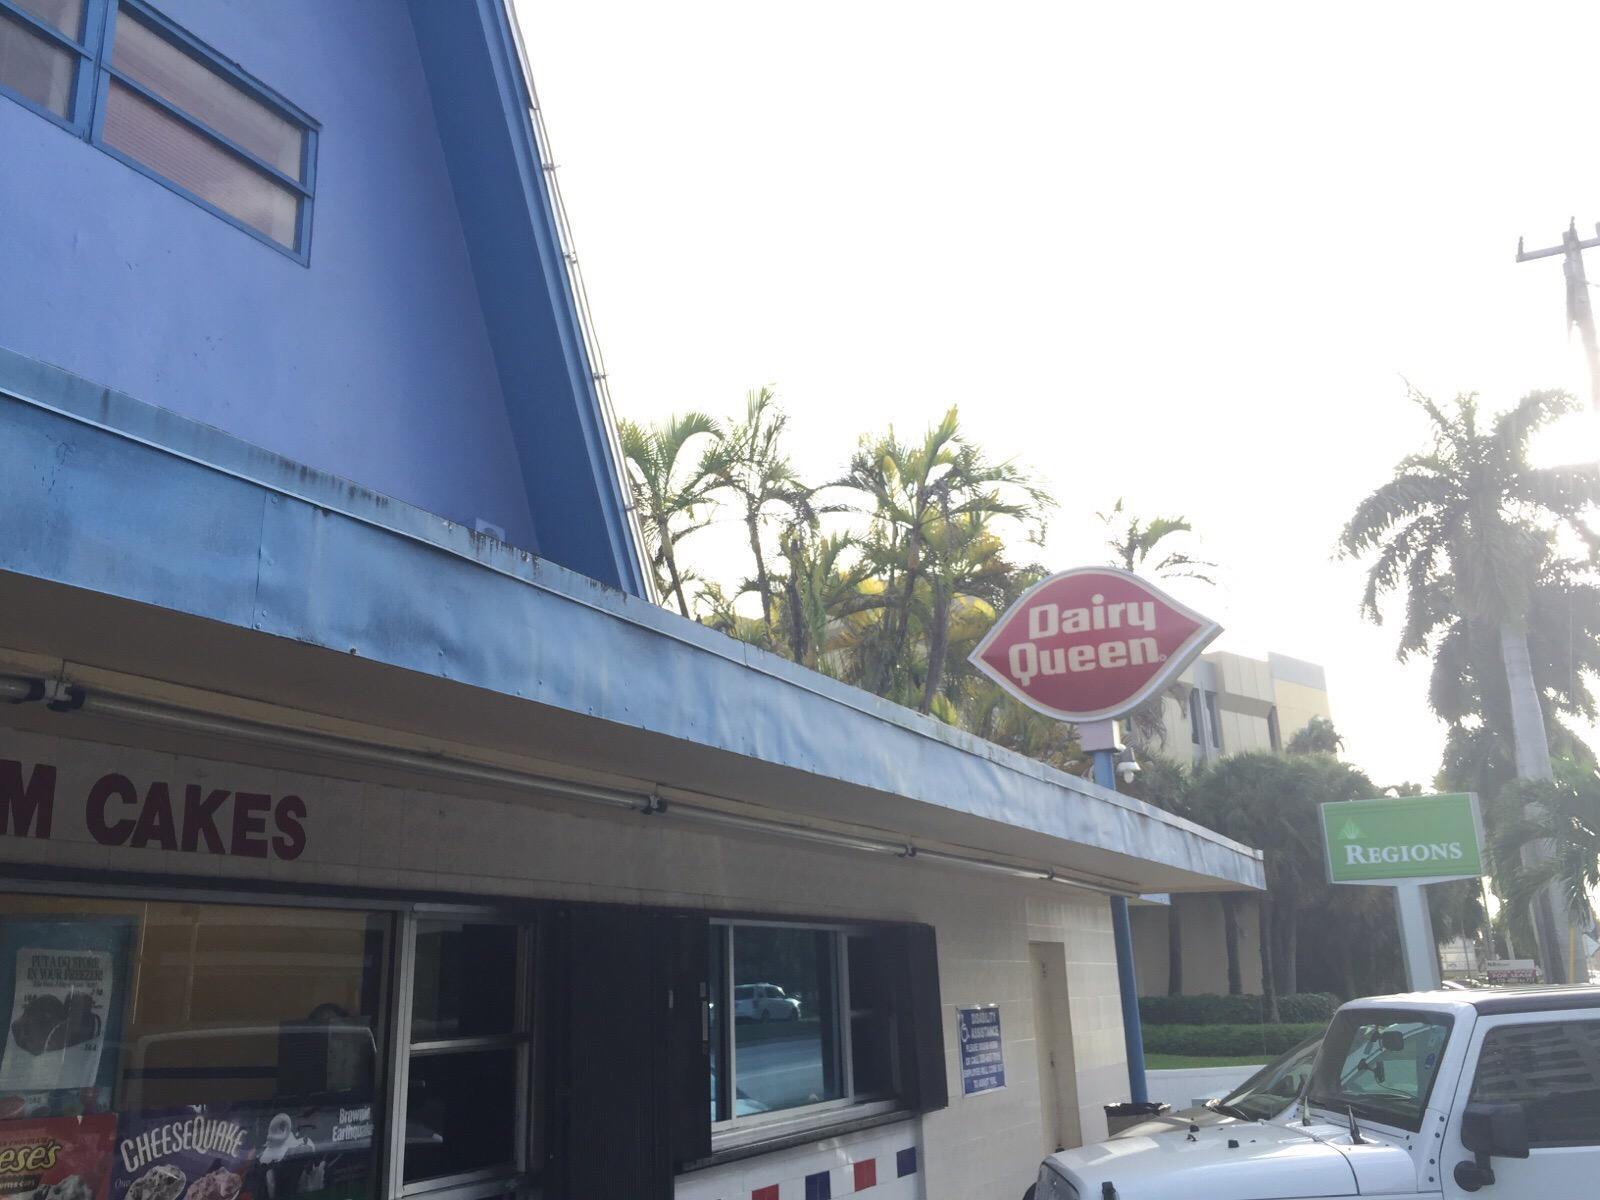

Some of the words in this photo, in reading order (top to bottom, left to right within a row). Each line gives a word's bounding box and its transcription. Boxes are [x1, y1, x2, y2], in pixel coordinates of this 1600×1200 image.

[1028, 594, 1157, 640] Dairy
[1008, 637, 1160, 687] Queen
[85, 772, 308, 861] CAKES
[1343, 842, 1463, 865] REGIONS
[120, 1115, 248, 1173] CHEESEQUAKE
